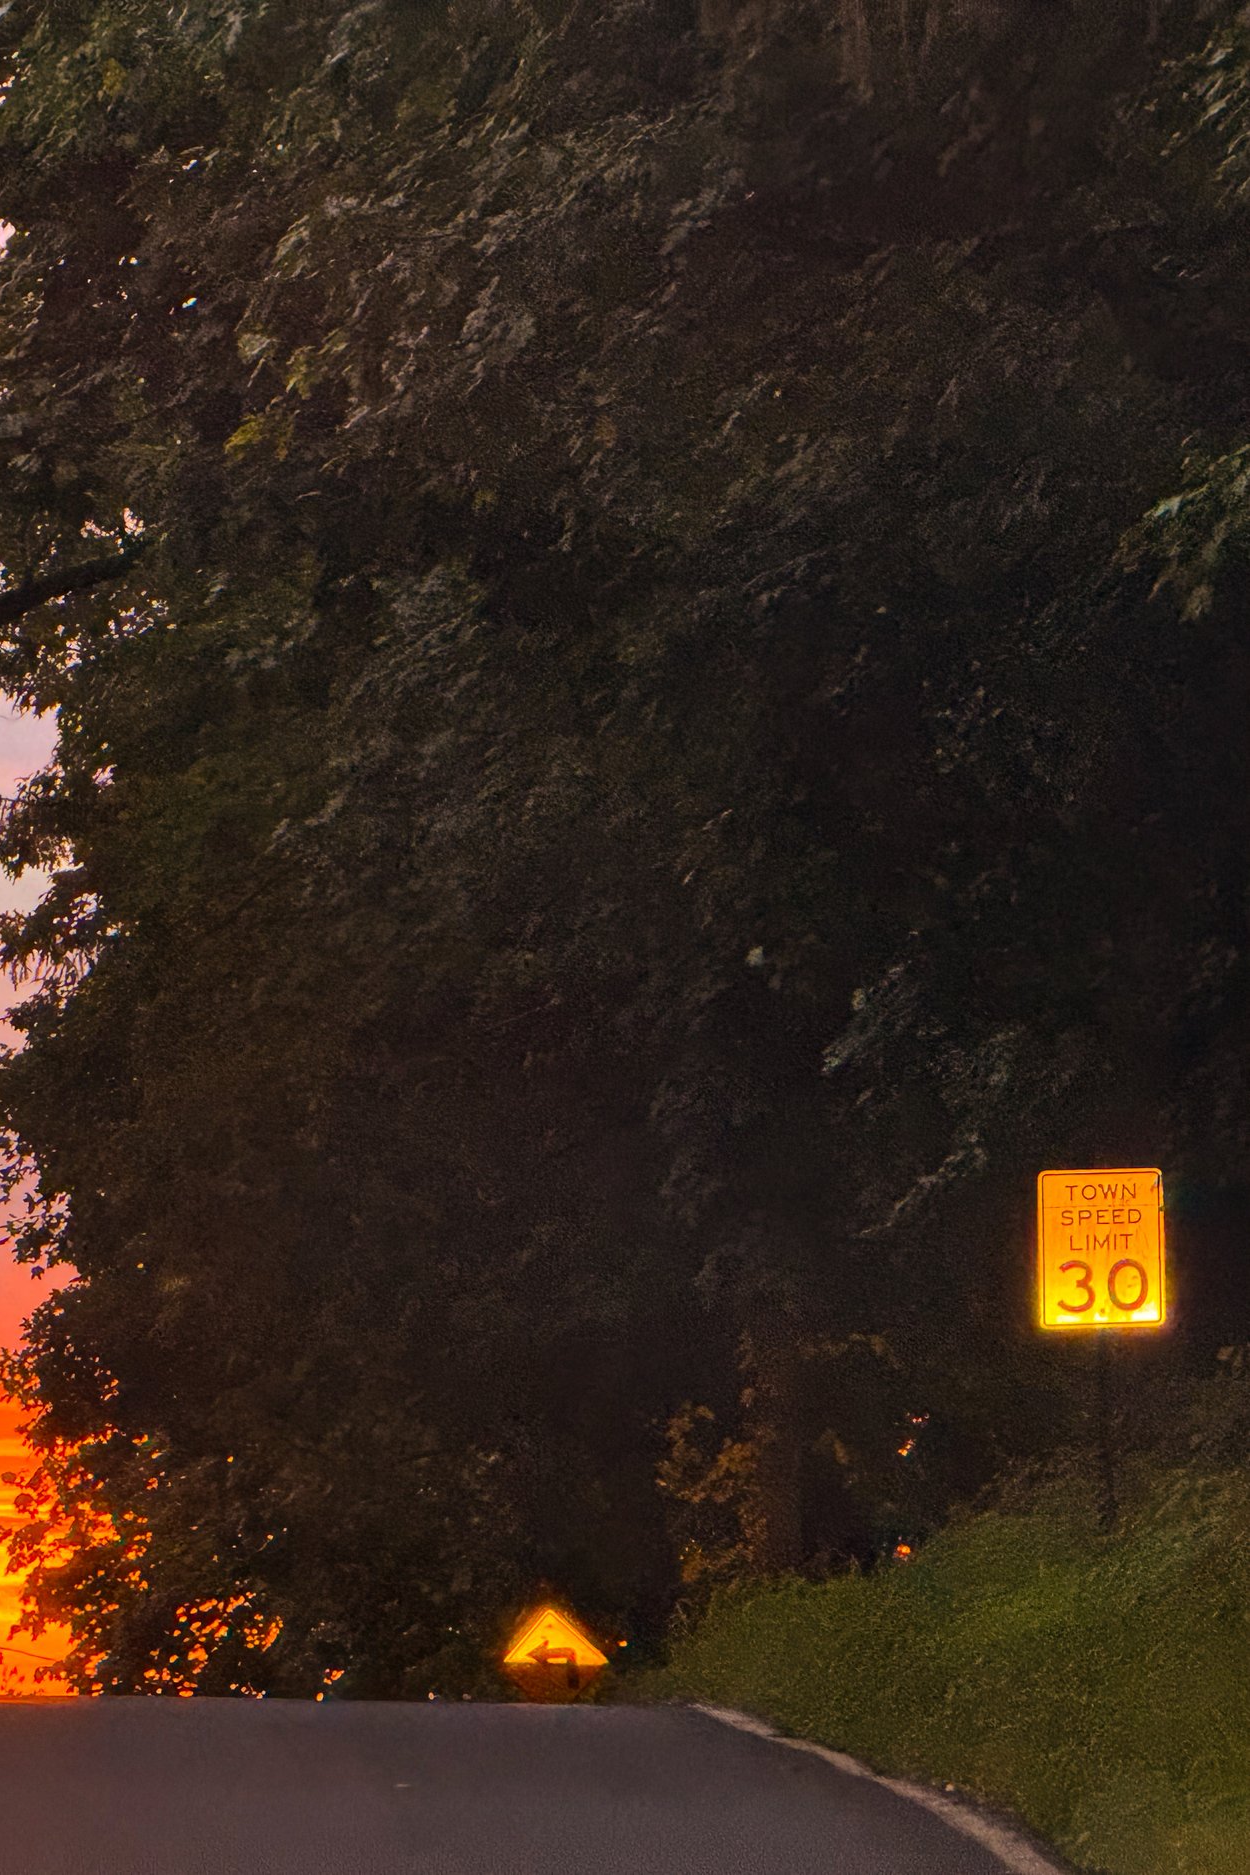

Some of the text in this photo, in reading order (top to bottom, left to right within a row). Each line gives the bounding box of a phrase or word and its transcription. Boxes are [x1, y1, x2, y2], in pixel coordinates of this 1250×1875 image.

[1065, 1183, 1137, 1201] TOWN
[1061, 1208, 1142, 1226] SPEED
[1069, 1233, 1134, 1251] LIMIT
[1057, 1258, 1149, 1313] 30
